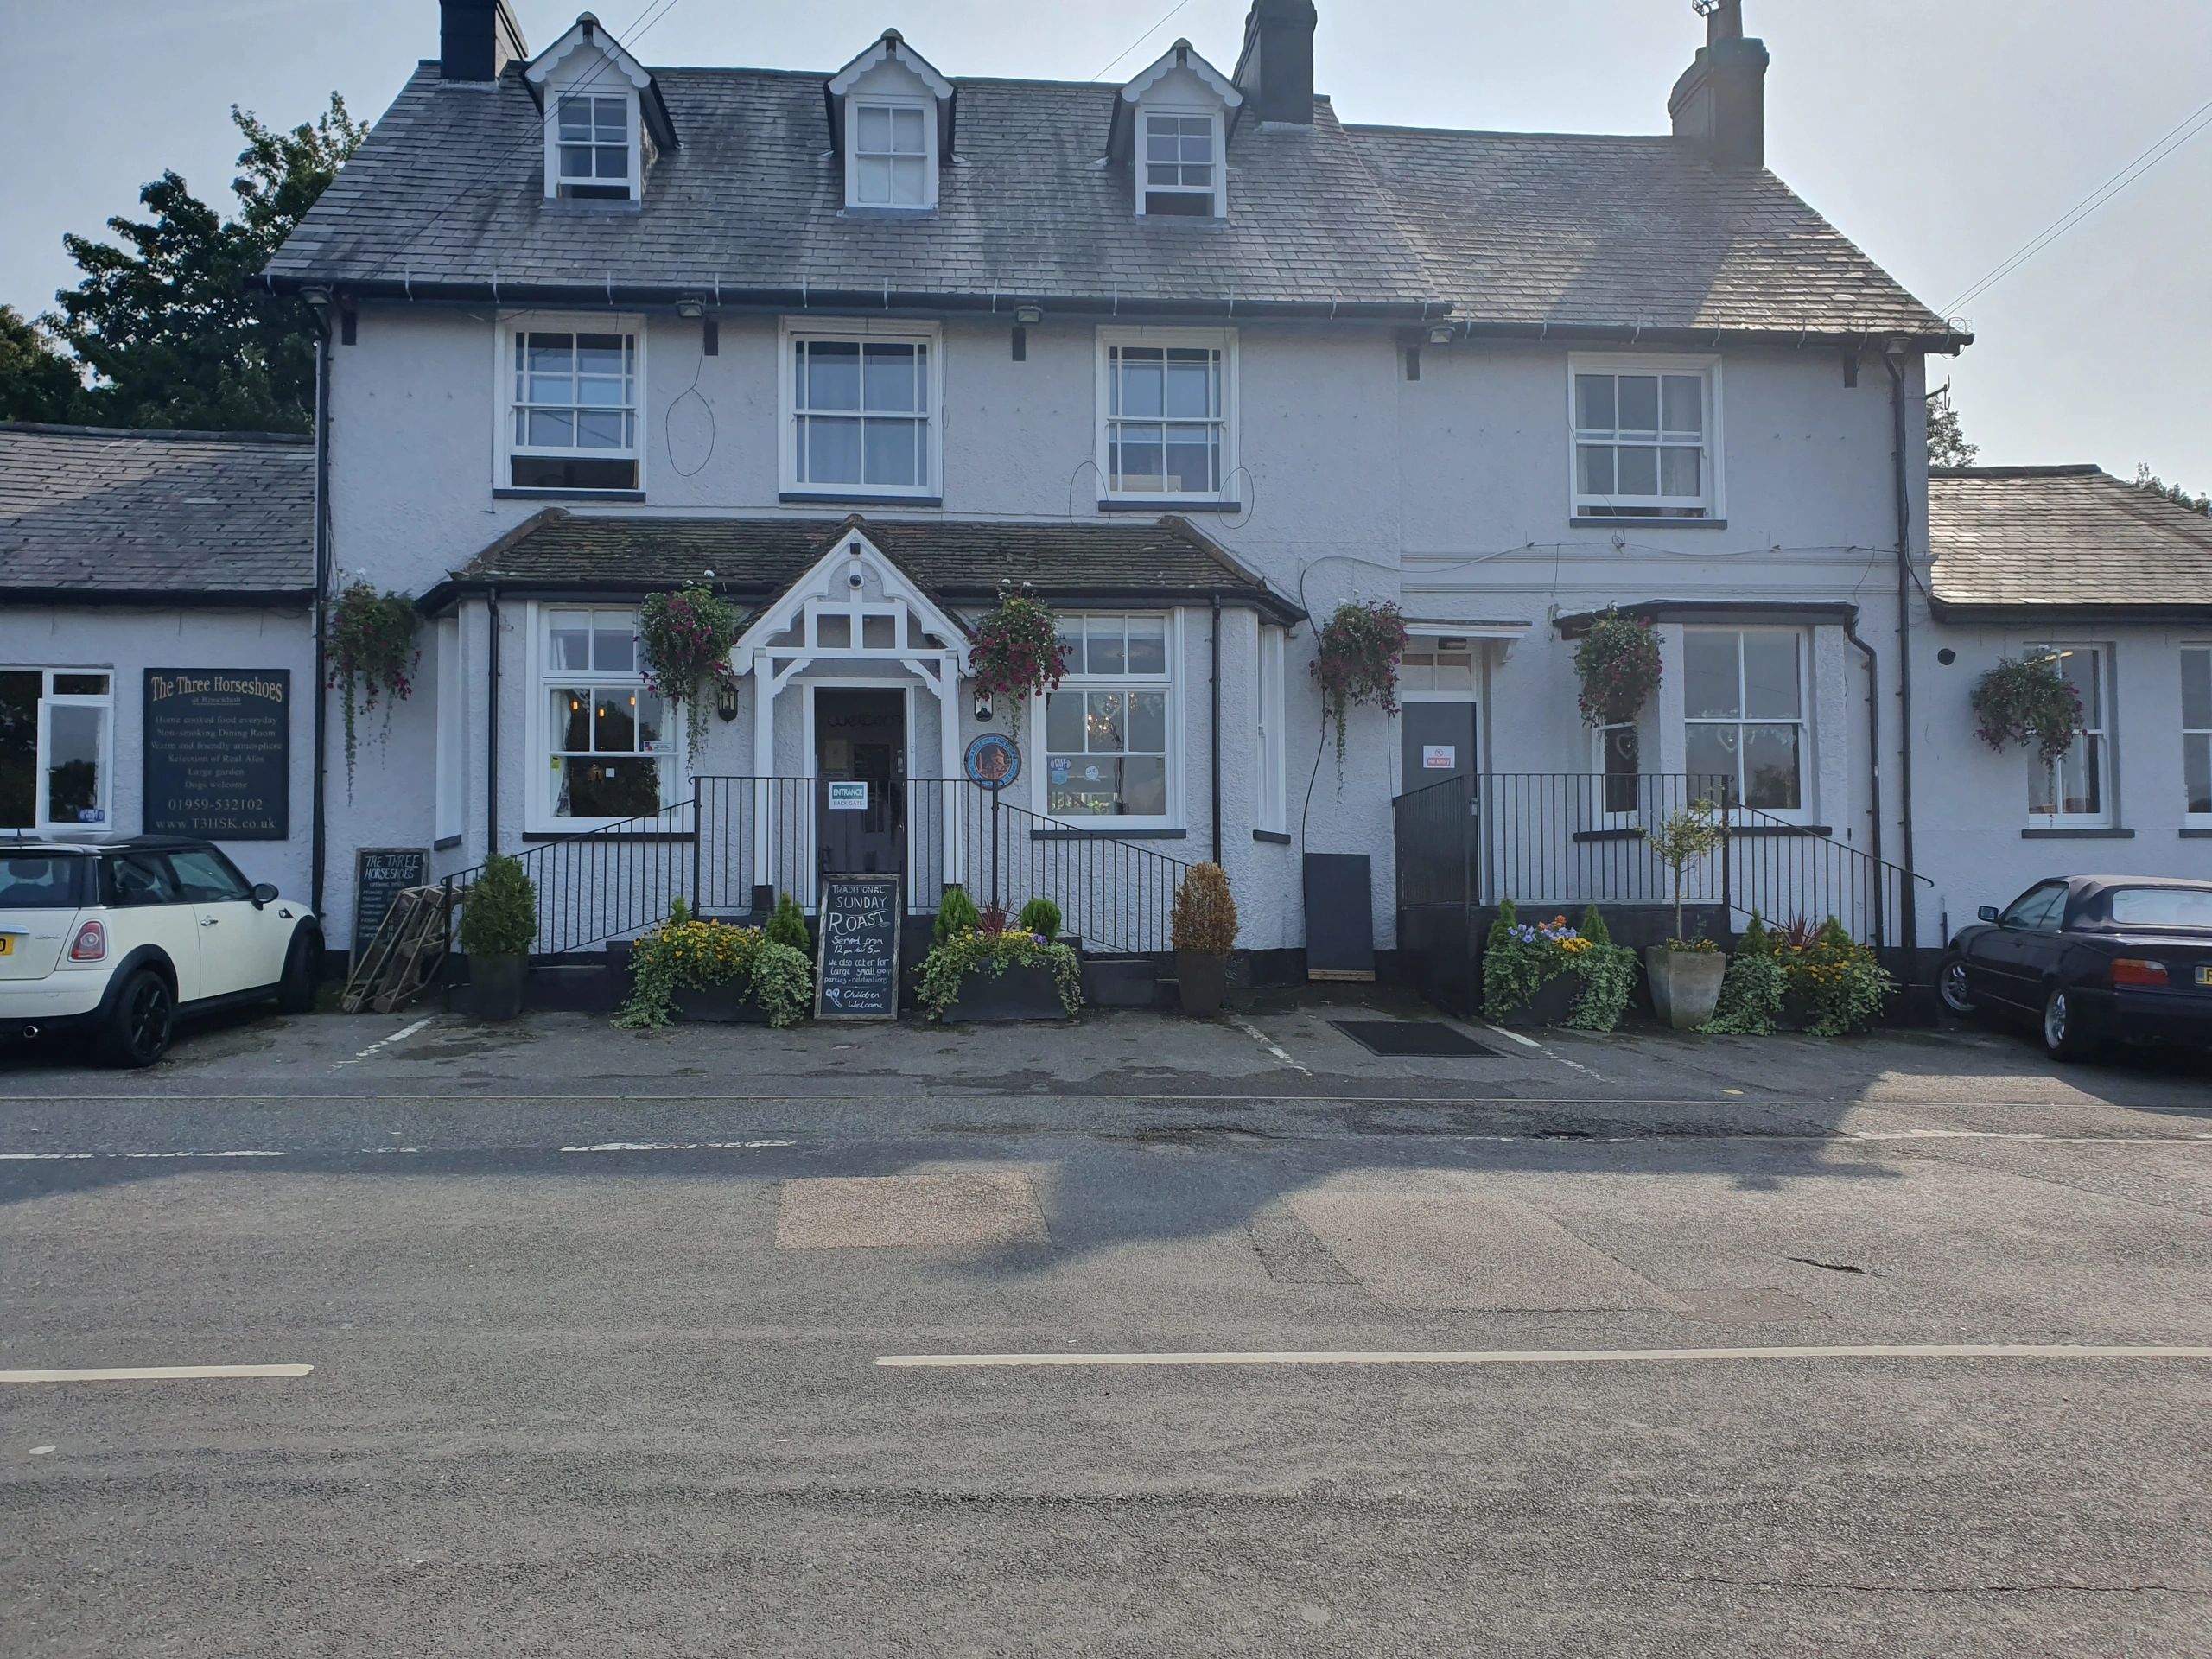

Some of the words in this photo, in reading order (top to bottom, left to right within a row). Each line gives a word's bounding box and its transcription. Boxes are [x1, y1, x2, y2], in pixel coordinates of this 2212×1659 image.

[151, 677, 174, 702] The
[176, 676, 211, 695] Three
[214, 677, 283, 703] Horseshoes
[238, 717, 277, 726] everyday
[219, 728, 248, 739] Dining
[197, 741, 230, 752] friendly
[188, 767, 212, 777] Large
[214, 767, 245, 777] garden
[185, 781, 207, 791] Dogs
[168, 799, 264, 810] 01959-532102
[365, 855, 383, 867] THE
[385, 855, 420, 868] THREE
[364, 868, 414, 881] HORSESHOES
[832, 885, 885, 893] TRADITIONAL
[836, 896, 887, 908] SUNDAY
[828, 911, 886, 935] ROAST
[831, 936, 861, 945] Served
[863, 938, 883, 947] from
[877, 957, 889, 966] for
[831, 968, 850, 976] large
